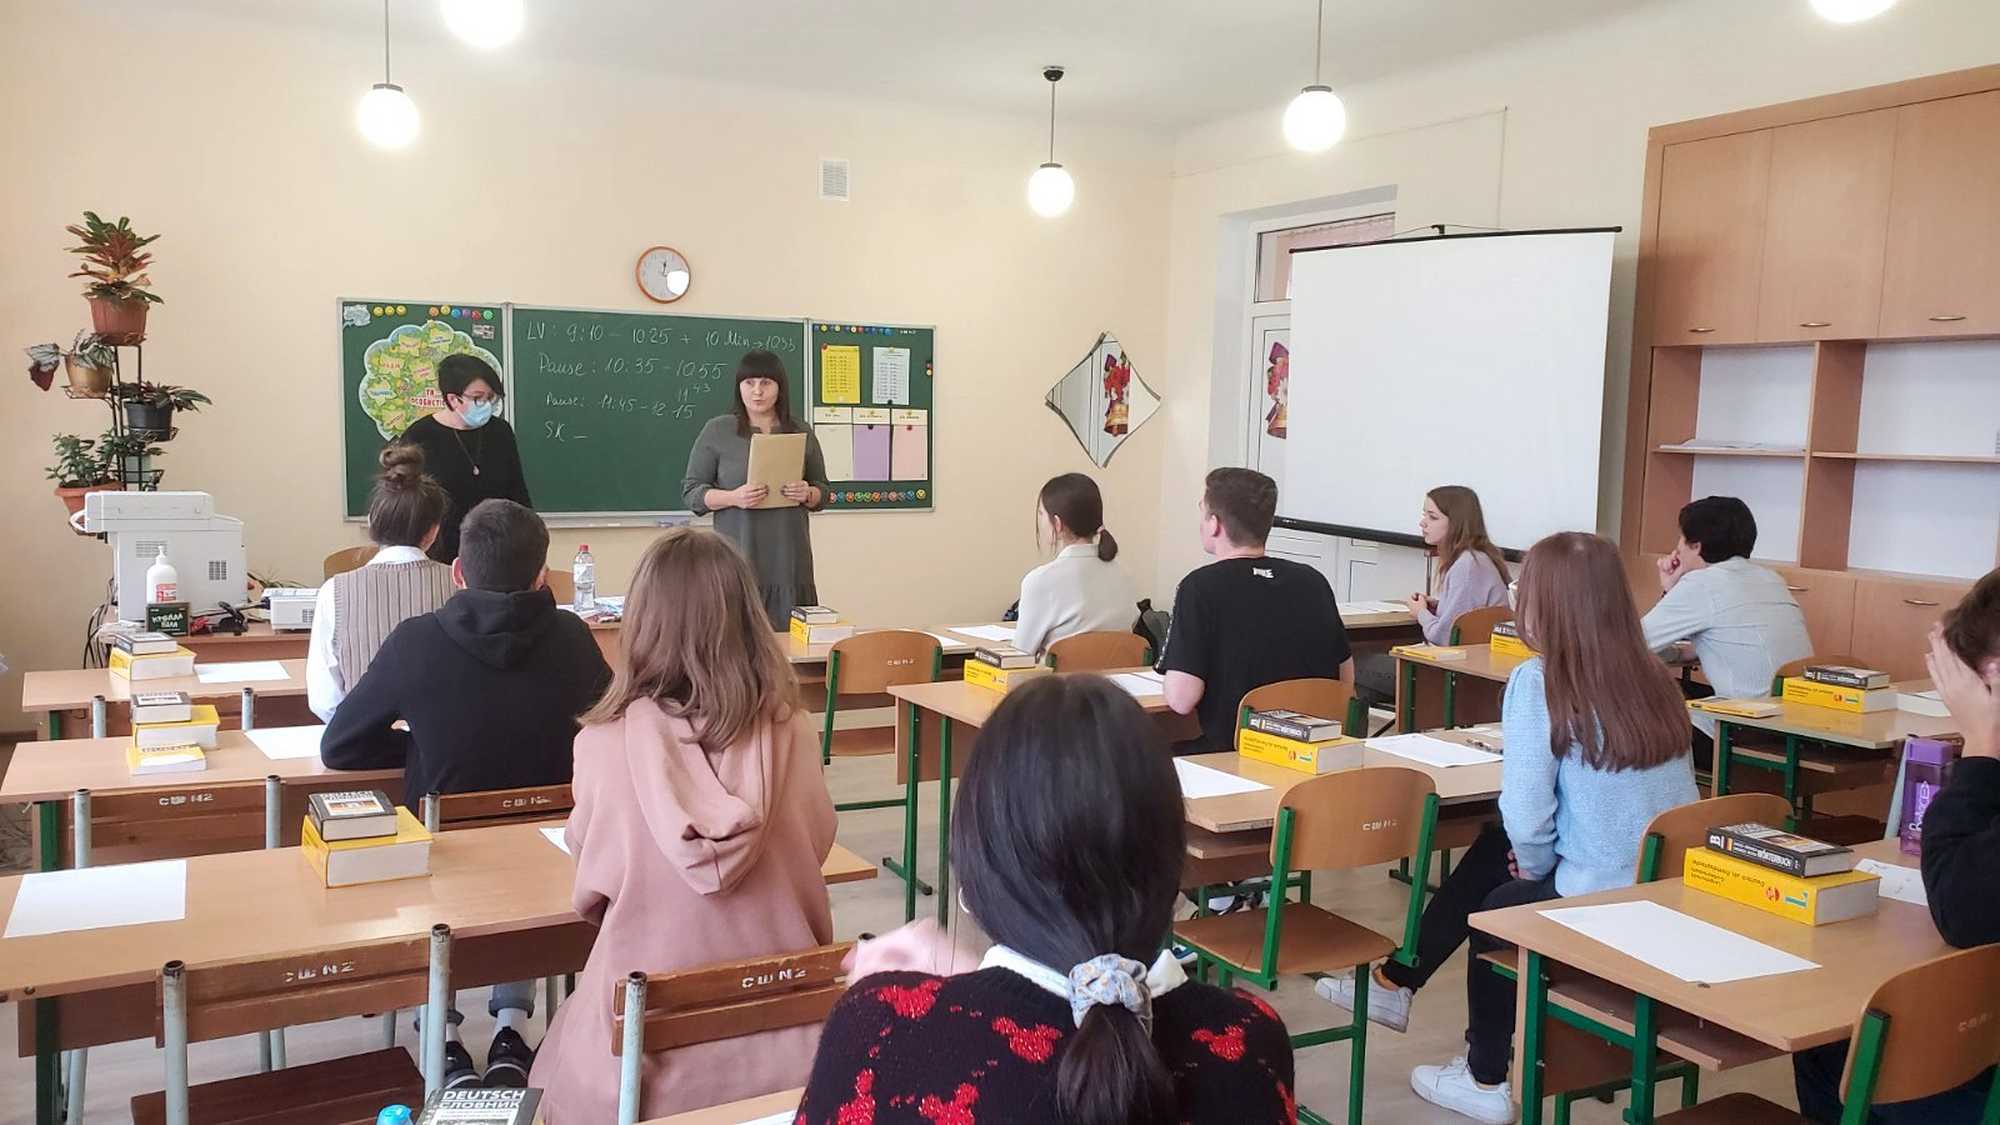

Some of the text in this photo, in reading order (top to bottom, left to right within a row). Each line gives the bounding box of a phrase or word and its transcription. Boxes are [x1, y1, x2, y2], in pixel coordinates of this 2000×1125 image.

[705, 330, 720, 349] 10
[442, 1090, 527, 1101] DEUTSCH
[439, 1101, 521, 1110] СЛОВНИК
